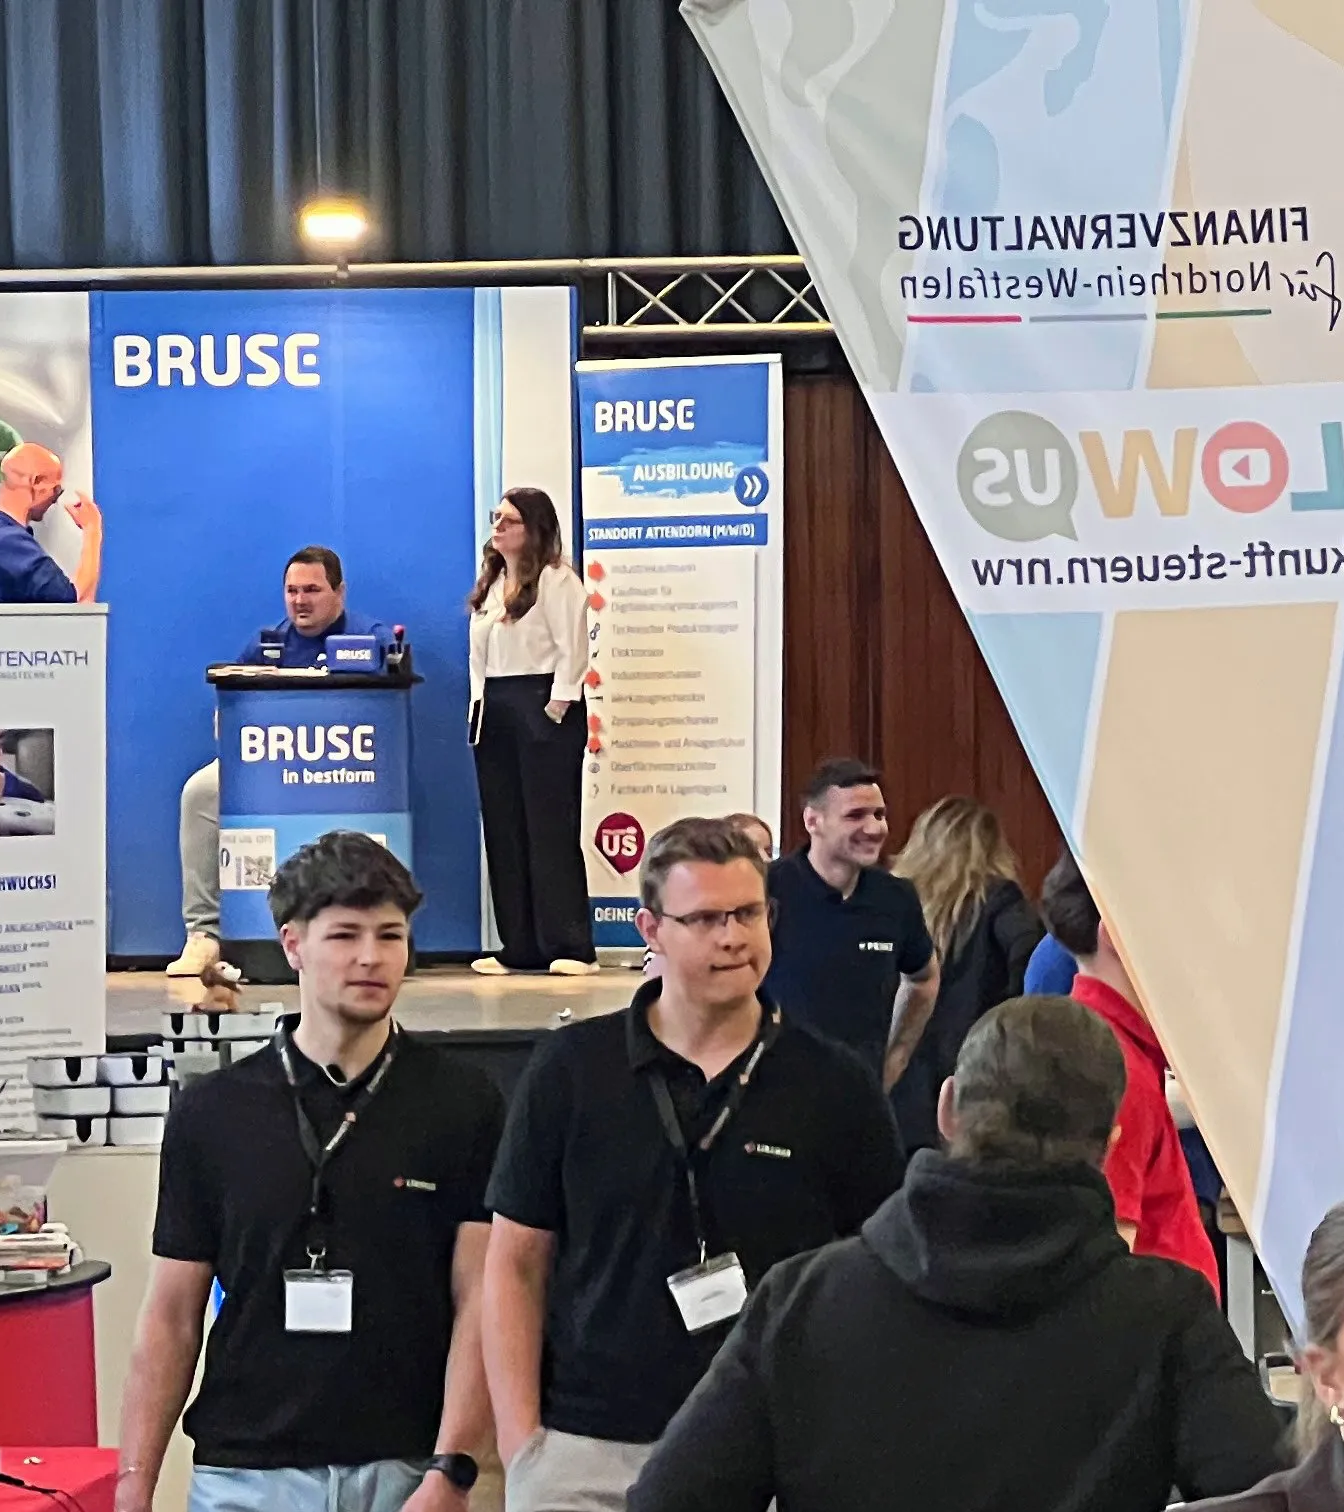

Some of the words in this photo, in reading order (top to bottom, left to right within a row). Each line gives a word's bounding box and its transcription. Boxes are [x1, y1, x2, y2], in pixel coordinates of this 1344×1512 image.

[113, 332, 321, 387] BRUSE
[594, 399, 696, 433] BRUSE
[633, 461, 735, 481] AUSBILDUNG
[588, 526, 642, 541] STANDORT
[645, 525, 711, 540] ATTENDORN
[336, 649, 371, 661] BRUSE
[240, 724, 376, 762] BRUSE
[282, 768, 299, 785] in
[303, 768, 376, 785] bestform
[601, 834, 638, 857] US
[594, 907, 635, 922] DEINE
